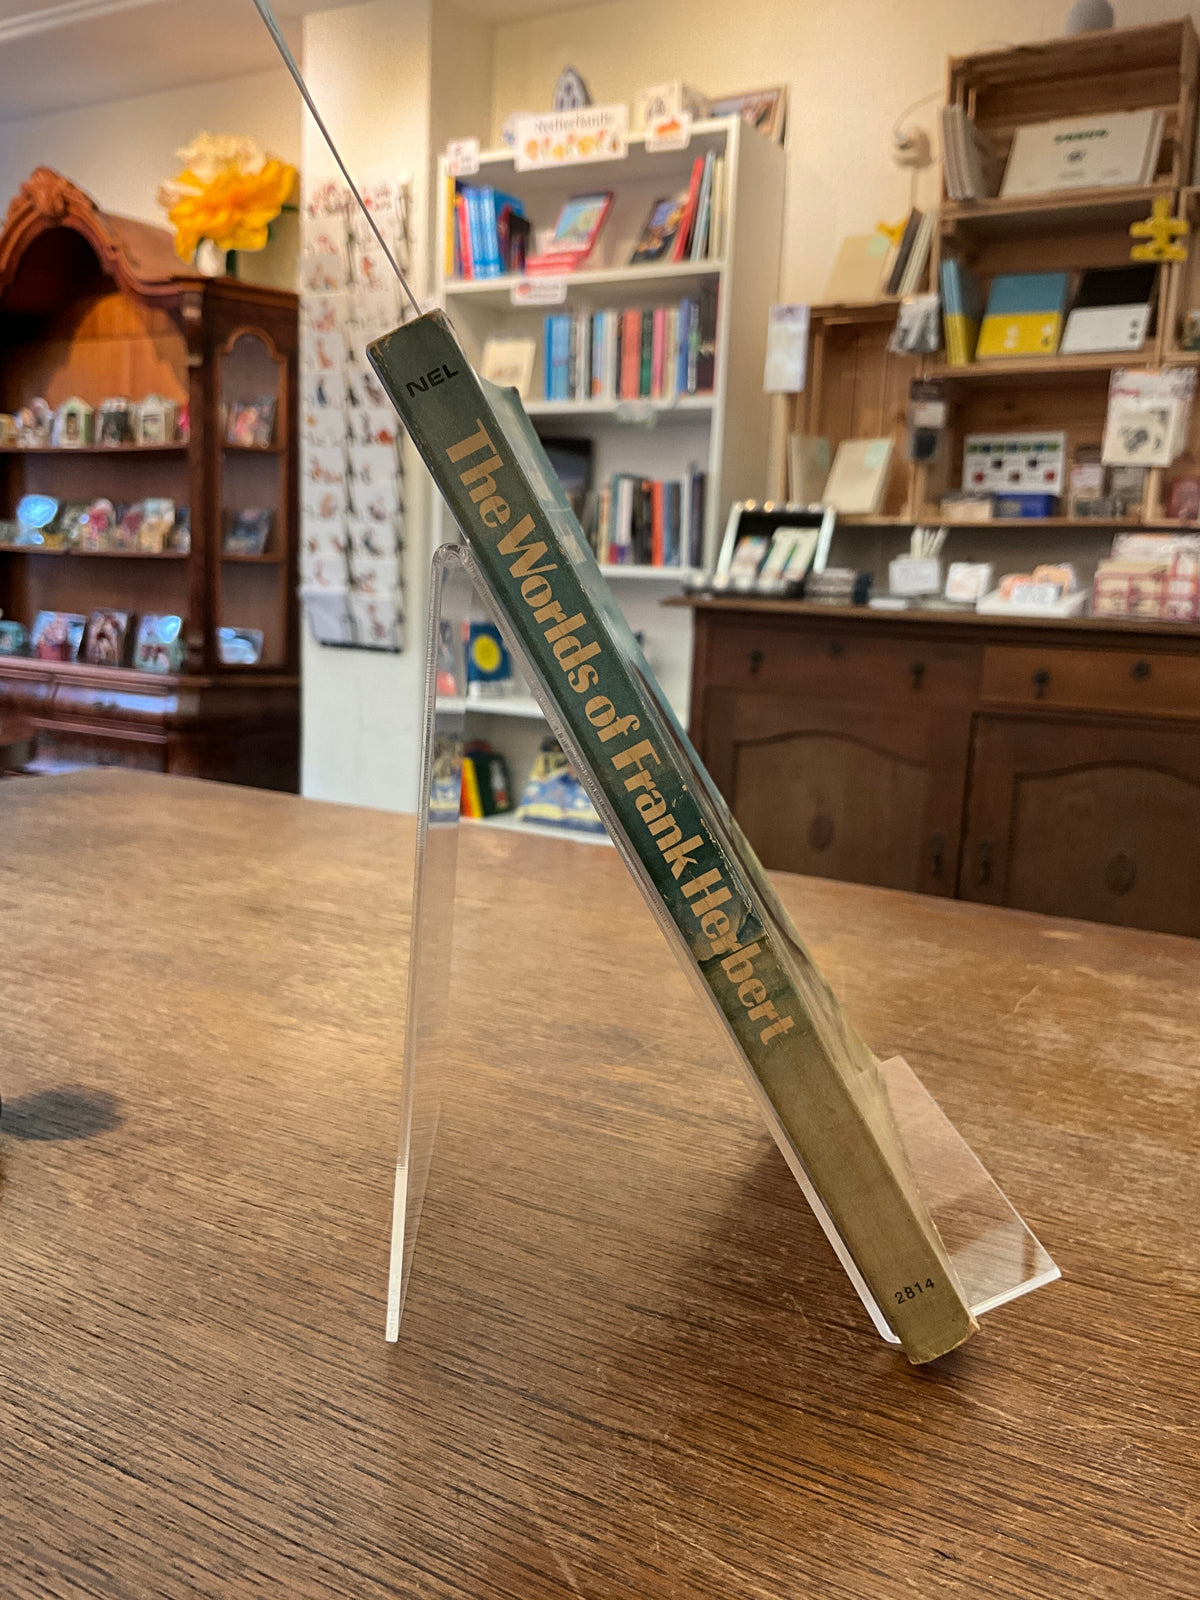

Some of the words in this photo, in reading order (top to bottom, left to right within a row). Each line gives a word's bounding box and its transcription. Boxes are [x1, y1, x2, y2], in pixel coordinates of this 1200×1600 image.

[405, 364, 459, 398] NEL
[445, 418, 511, 528] The
[497, 513, 602, 694] Worlds
[585, 695, 641, 743] of
[611, 739, 705, 880] Frank
[680, 867, 795, 1046] Herbert
[894, 1278, 935, 1305] 2814
